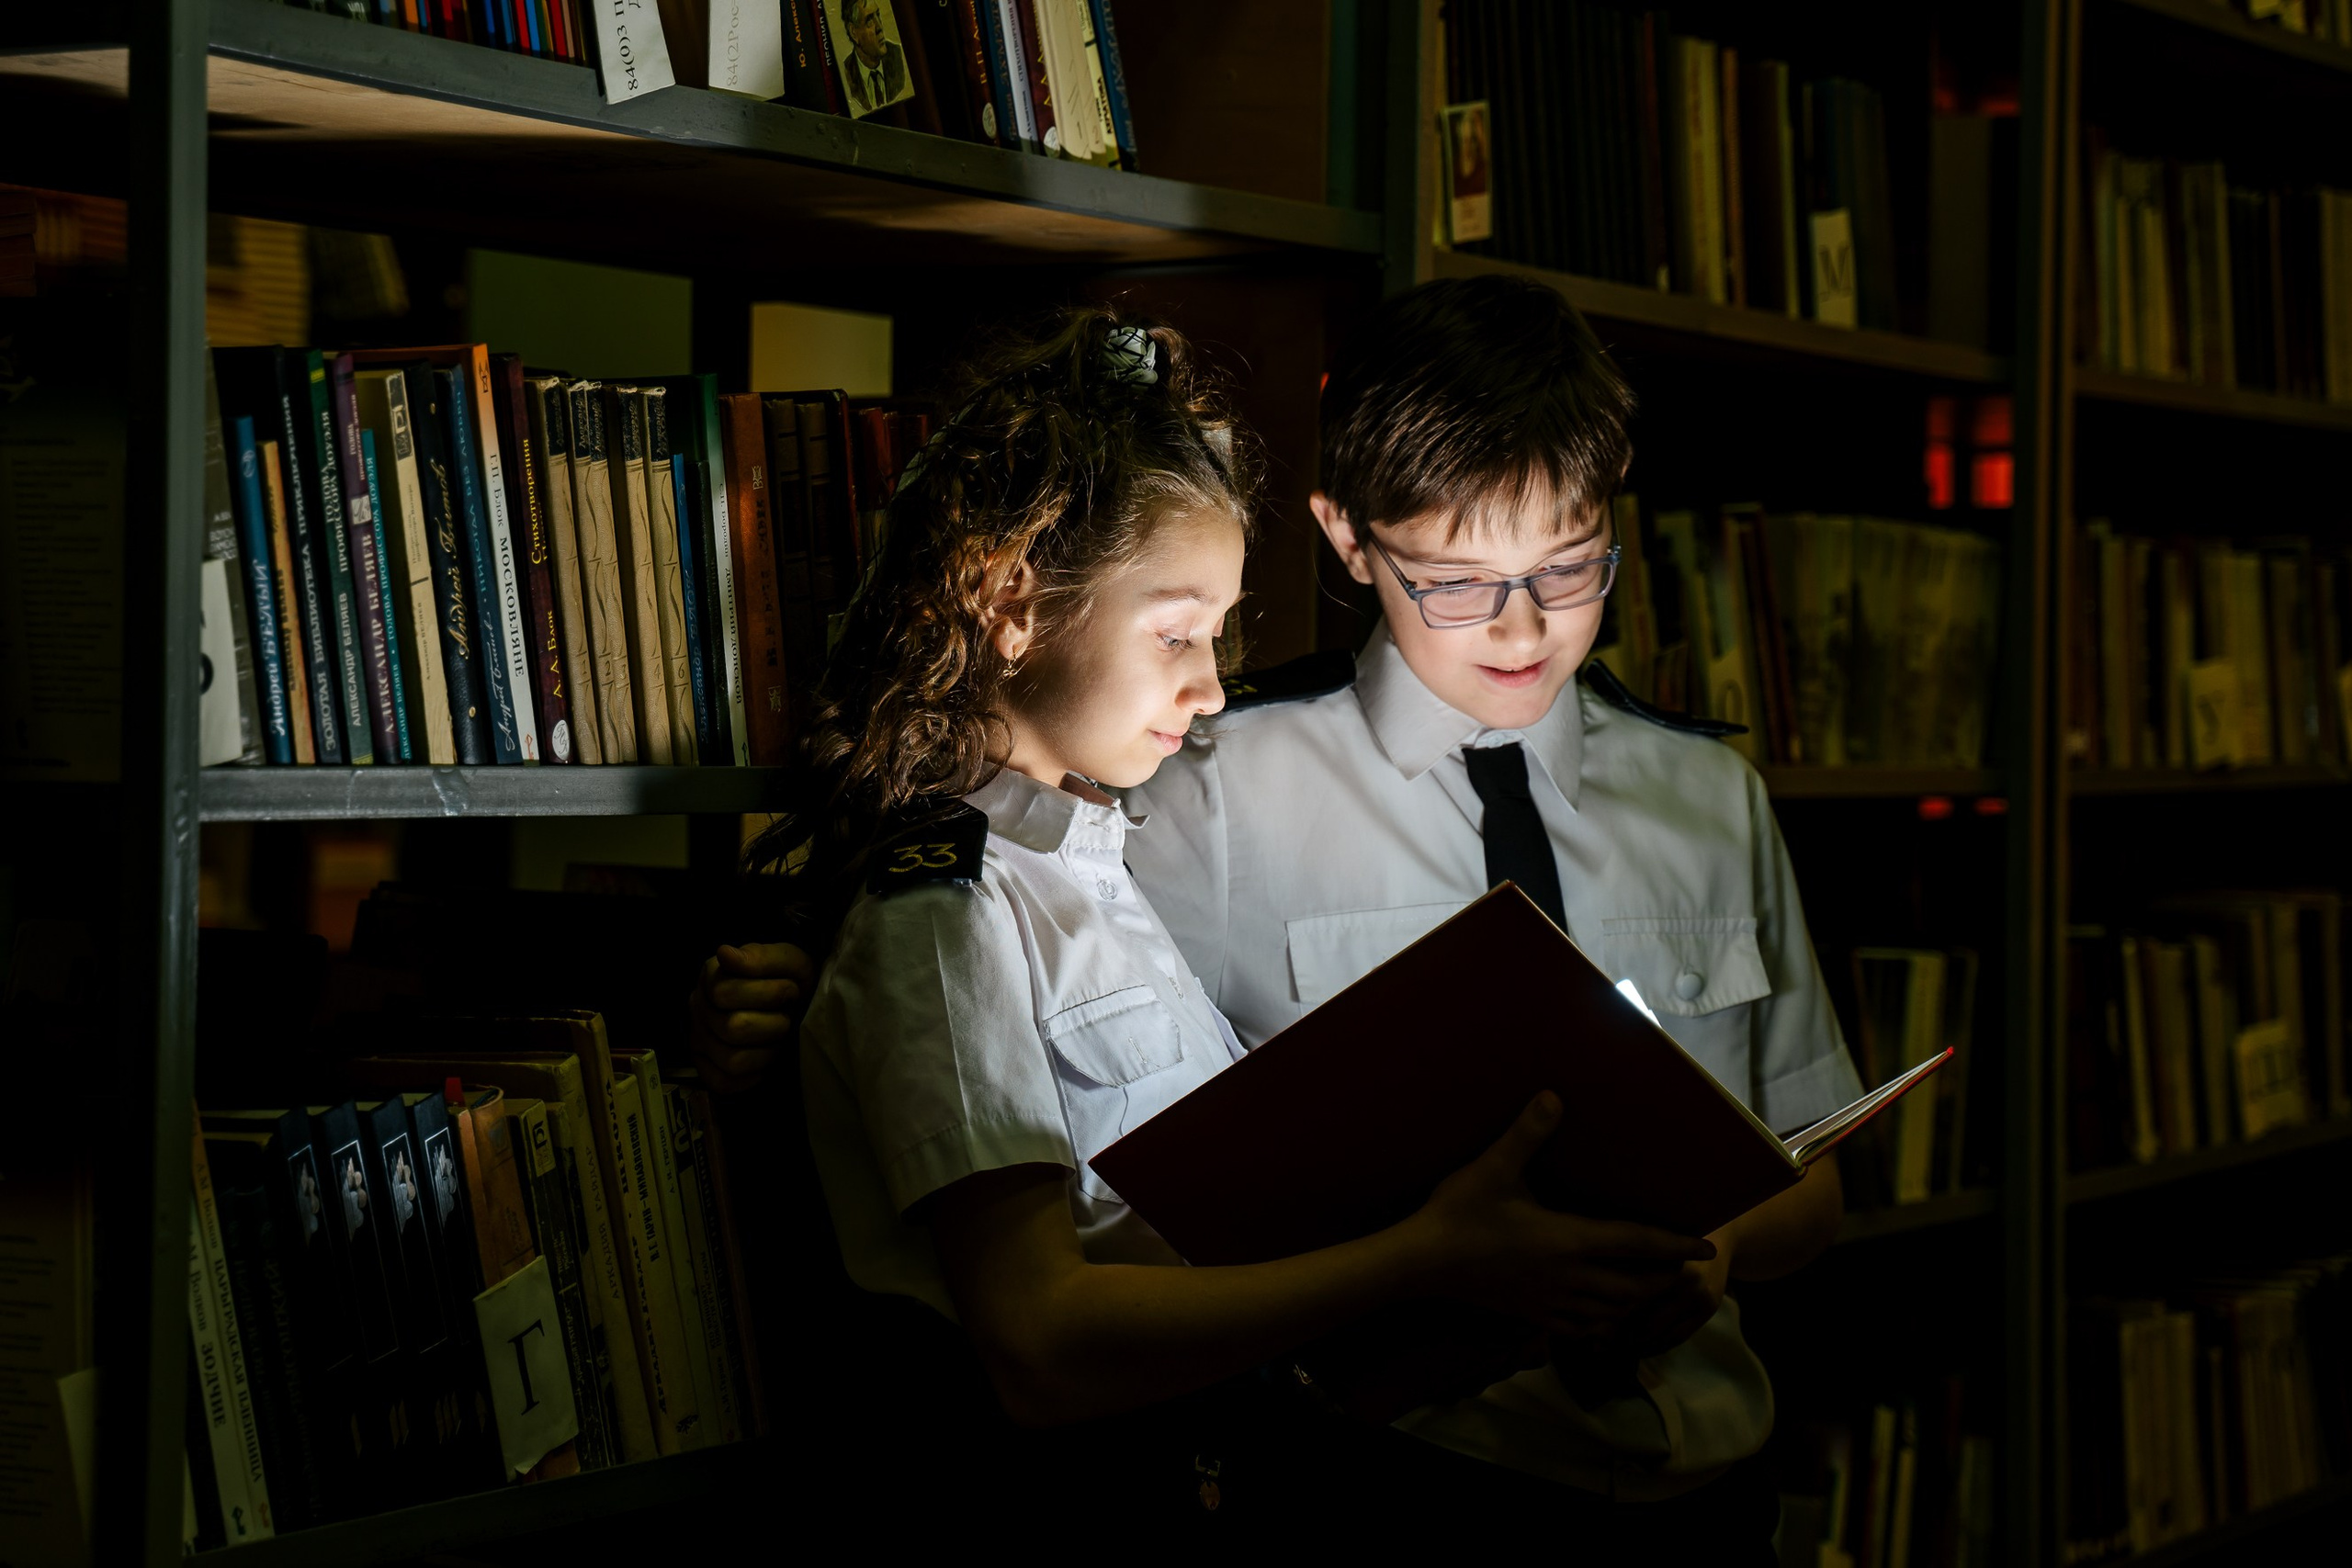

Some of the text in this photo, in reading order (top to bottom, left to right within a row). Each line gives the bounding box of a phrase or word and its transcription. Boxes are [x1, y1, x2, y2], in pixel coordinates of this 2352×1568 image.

[616, 25, 639, 91] 84(0)3
[790, 0, 802, 43] Алекс
[347, 423, 356, 455] ГОЛОВА
[463, 465, 472, 496] БЕЗ
[321, 465, 334, 524] ГОЛОВА
[322, 411, 348, 572] ПРОФЕССОРА ДОУЭЛЯ
[522, 439, 542, 565] Стихотворения
[282, 394, 336, 751] ЗОЛОТАЯ БИБЛИОТЕКА ПРИКЛЮЧЕНИЙ
[367, 457, 412, 759] ЛЕКСАНДР БЕЛЯЕВ ГОЛОВА ПРОФЕССОРА ДОУЭЛЯ
[447, 566, 469, 660] Андрей
[500, 537, 525, 676] МОСКОВЛЯНЕ
[338, 592, 362, 727] АЛЕКСАНДР БЕЛЯЕВ
[360, 534, 395, 733] АЛЕКСАНДР БЕЛЯЕВ
[547, 610, 557, 651] Блок
[677, 662, 685, 680] 6
[266, 663, 285, 735] Андрей
[888, 842, 958, 873] 33
[659, 1124, 671, 1167] ГЕРЦЕН
[585, 1146, 620, 1300] АРКАДИЙ ГАЙДАР
[190, 1269, 207, 1332] Волков
[202, 1341, 226, 1427] ЗОДЧИЕ
[204, 1199, 219, 1248] Волков
[213, 1258, 245, 1385] ЦАРЬГРАДСКАЯ
[237, 1390, 264, 1483] ПЛЕННИЦА
[507, 1319, 544, 1416] Г
